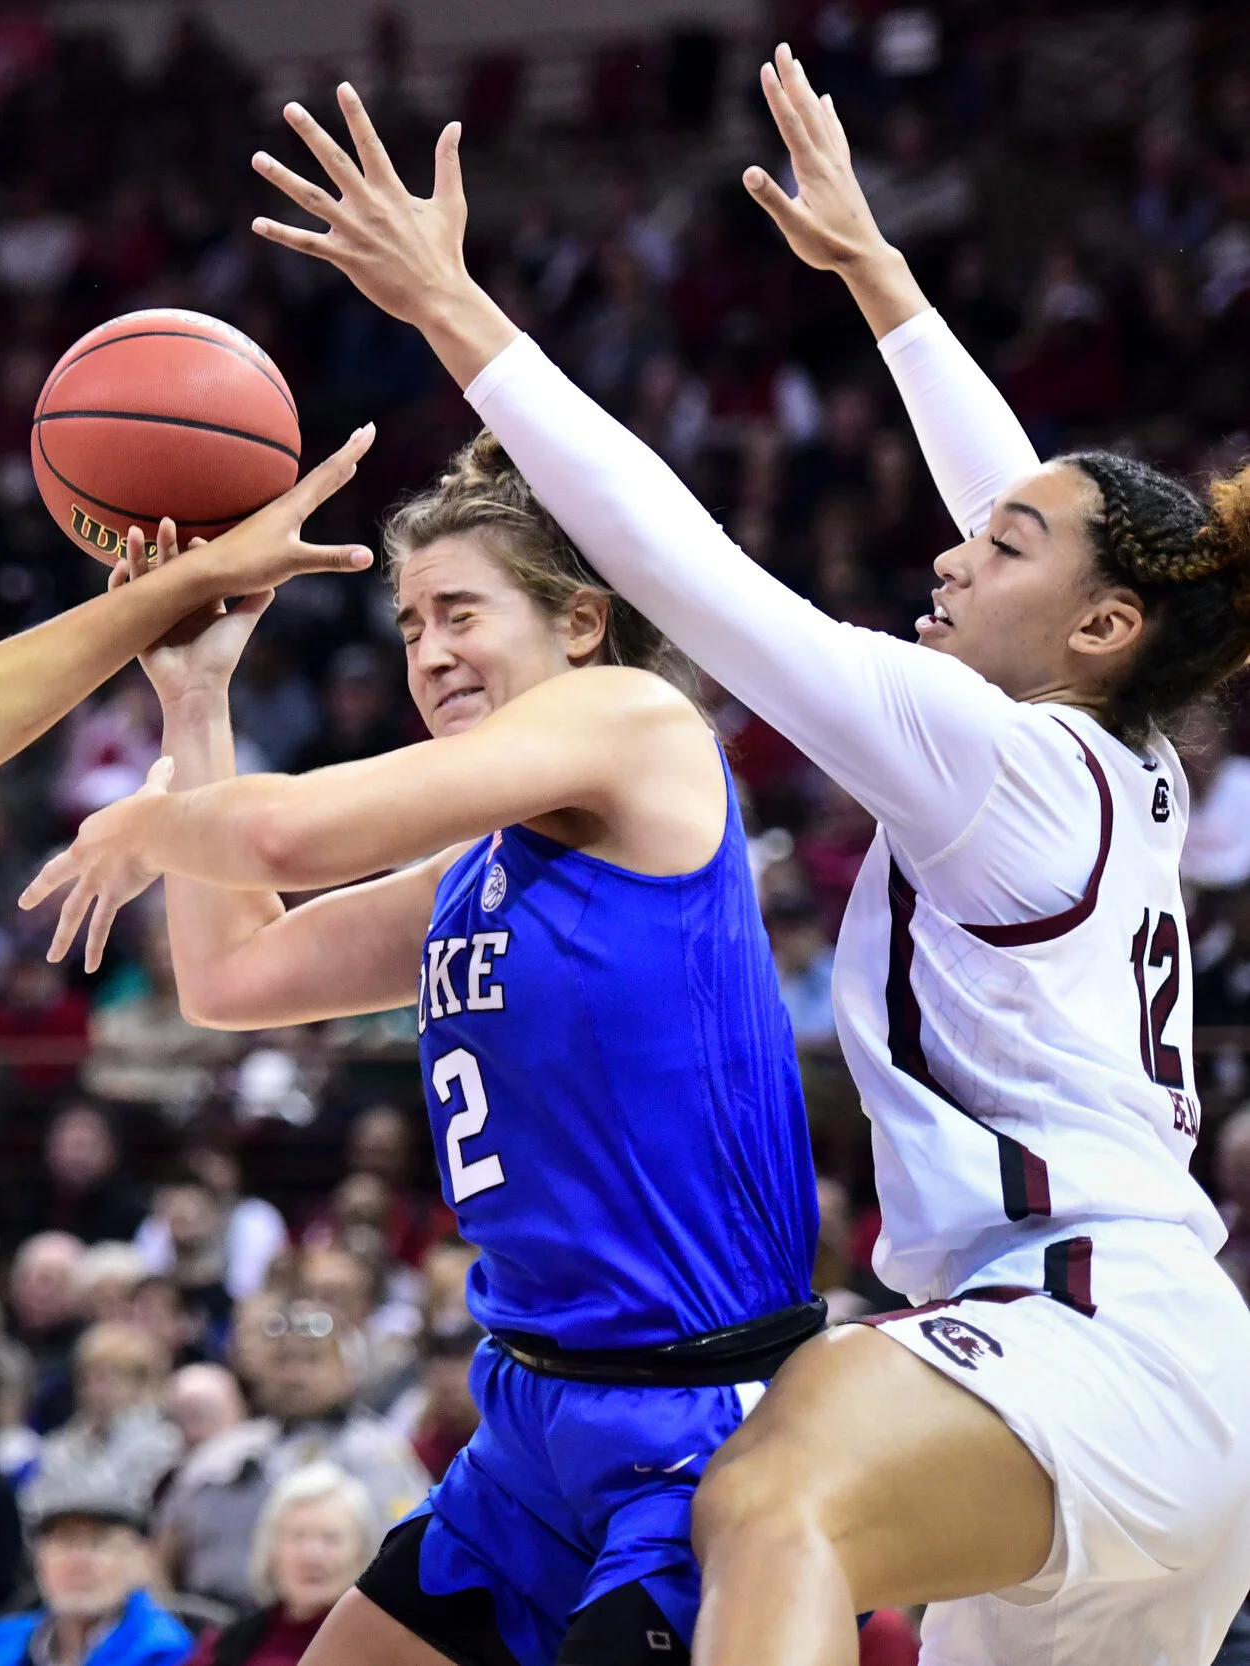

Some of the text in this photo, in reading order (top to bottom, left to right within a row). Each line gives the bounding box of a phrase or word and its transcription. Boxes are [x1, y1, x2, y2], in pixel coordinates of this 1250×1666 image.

[1129, 906, 1184, 1090] 12
[431, 1046, 507, 1204] 2
[1166, 1088, 1200, 1142] BEA
